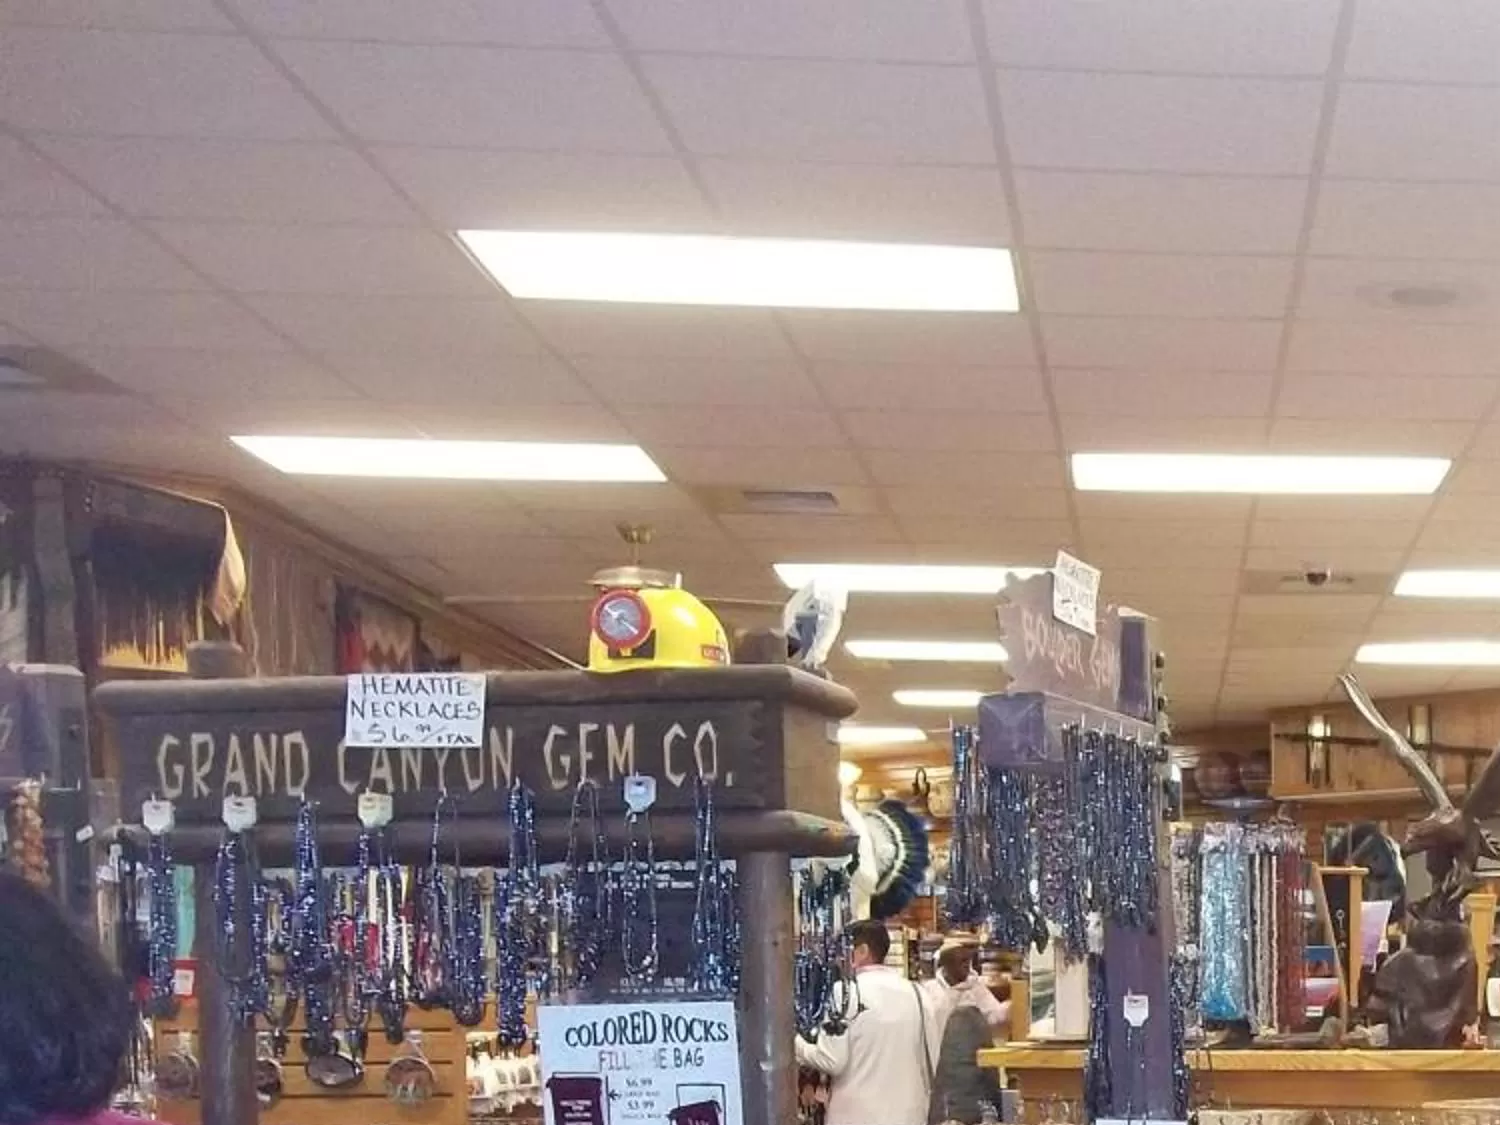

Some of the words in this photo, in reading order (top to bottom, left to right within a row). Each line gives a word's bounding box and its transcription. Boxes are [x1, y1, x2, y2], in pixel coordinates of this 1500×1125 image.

[361, 675, 471, 697] HEMATITE
[350, 700, 482, 721] NECKLACES
[157, 730, 310, 799] GRAND
[337, 726, 514, 795] CANYON
[543, 721, 635, 790] GEM
[663, 720, 735, 787] CO.
[565, 1010, 657, 1047] COLORED
[661, 1013, 729, 1043] ROCKS
[599, 1049, 630, 1071] FILL
[673, 1047, 705, 1068] BAG
